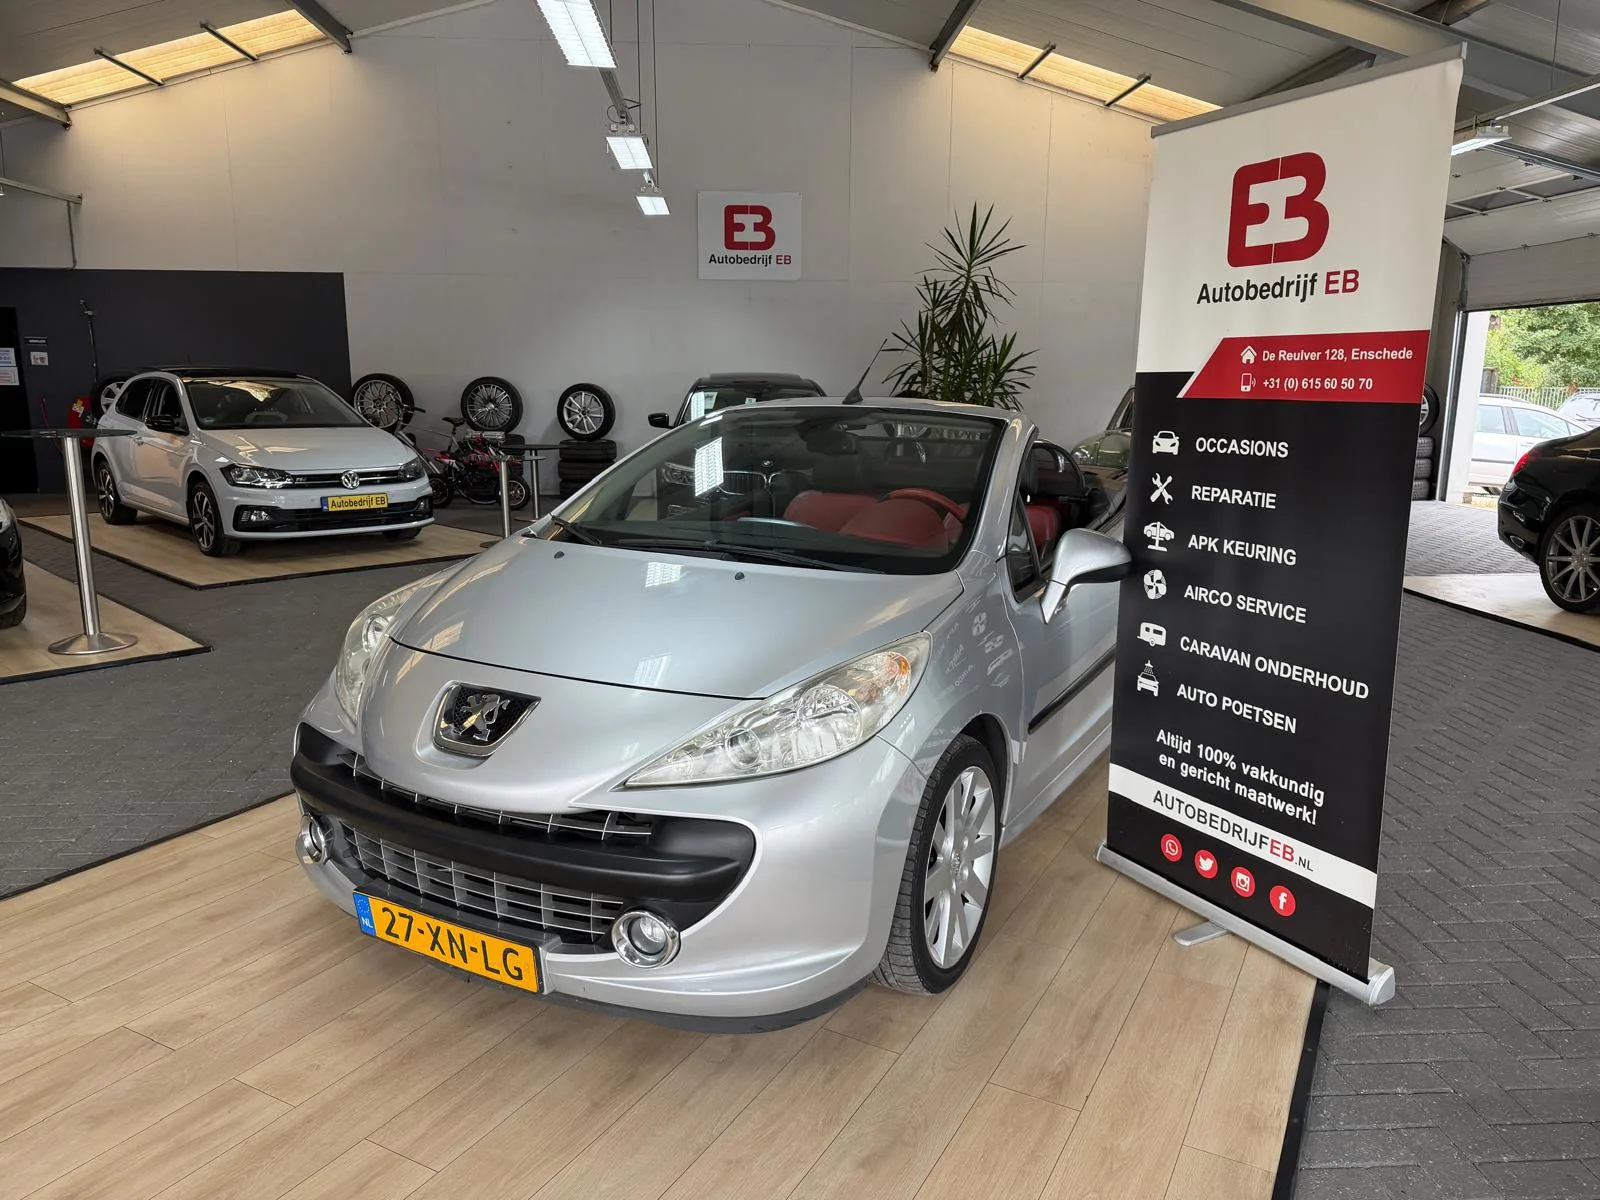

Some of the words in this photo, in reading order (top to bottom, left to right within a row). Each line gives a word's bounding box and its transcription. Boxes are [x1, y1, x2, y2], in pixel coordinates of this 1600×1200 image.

[708, 254, 772, 267] Autobedrijf
[775, 255, 792, 265] EB
[1196, 272, 1318, 305] Autobedrijf
[1324, 269, 1360, 295] EB
[1262, 350, 1276, 361] De
[1278, 350, 1321, 361] Reulver
[1324, 348, 1348, 362] 128,
[1351, 347, 1413, 360] Enschede
[1263, 377, 1281, 390] +31
[1283, 377, 1299, 391] (0)
[1301, 377, 1322, 390] 615
[1324, 377, 1338, 390] 60
[1340, 377, 1355, 390] 50
[1358, 377, 1374, 390] 70
[1195, 437, 1289, 458] OCCASIONS
[331, 497, 373, 508] Autobedrijf
[376, 496, 386, 506] EB
[1191, 485, 1277, 509] REPARATIE
[1188, 534, 1219, 553] APK
[1223, 539, 1297, 566] KEURING
[1184, 585, 1232, 607] AIRCO
[1236, 594, 1307, 623] SERVICE
[1180, 636, 1251, 669] CARAVAN
[1254, 656, 1369, 700] ONDERHOUD
[1176, 683, 1218, 708] AUTO
[1221, 696, 1297, 734] POETSEN
[1156, 729, 1191, 754] Altijd
[1196, 743, 1237, 771] 100%
[1241, 762, 1325, 807] vakkundig
[1158, 753, 1176, 769] en
[1180, 763, 1230, 791] gericht
[1235, 780, 1317, 825] maatwerk!
[1153, 789, 1314, 872] AUTOBEDRIJFEB.NL
[361, 916, 374, 928] NL
[382, 906, 523, 981] 27-XN-LG
